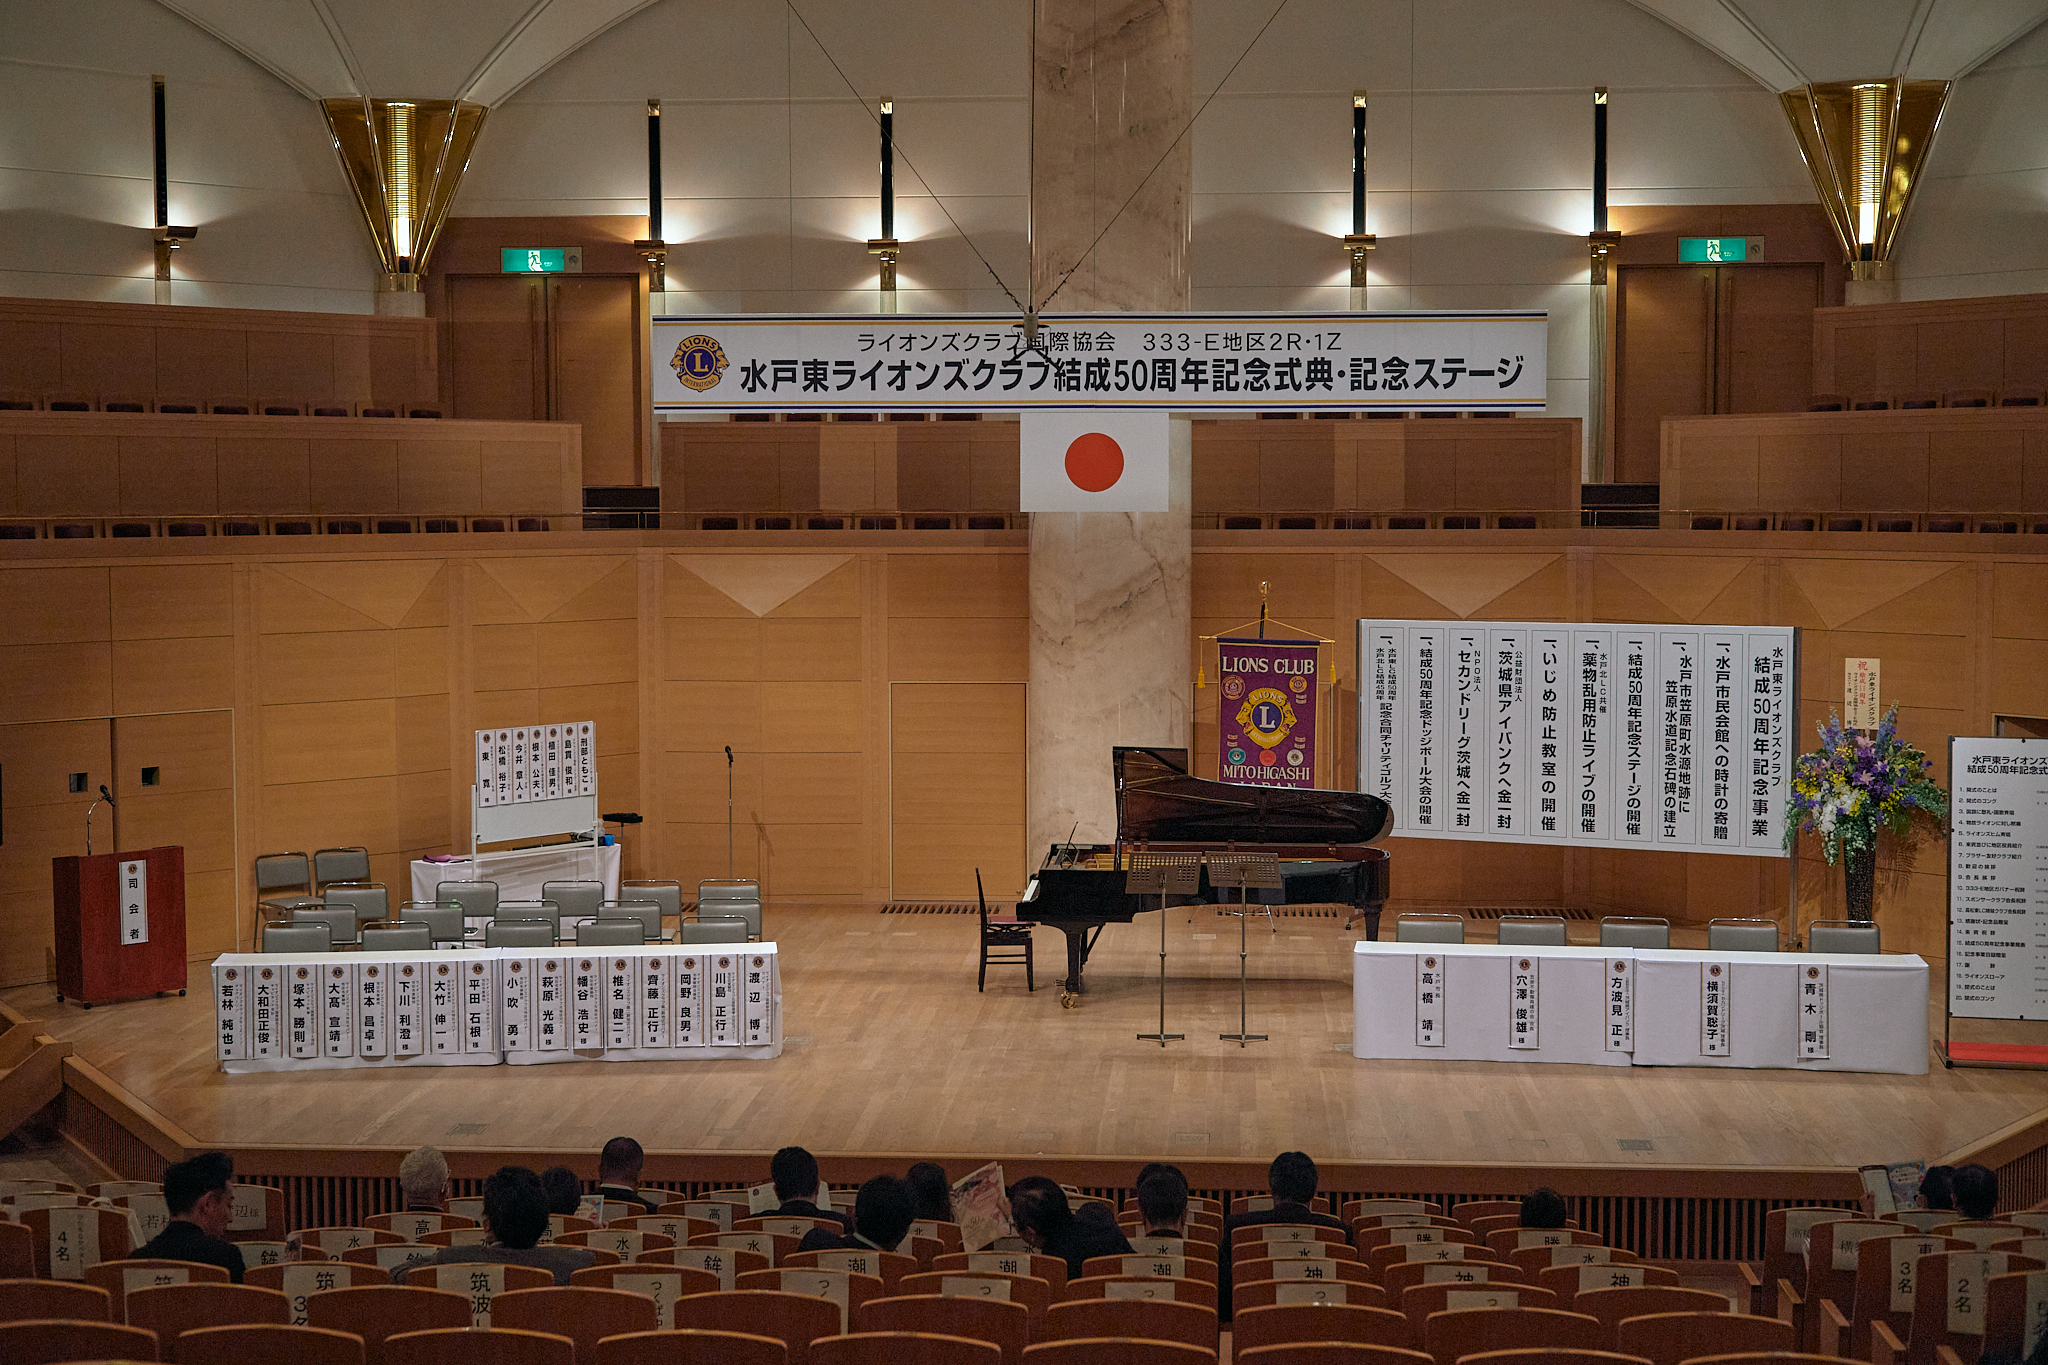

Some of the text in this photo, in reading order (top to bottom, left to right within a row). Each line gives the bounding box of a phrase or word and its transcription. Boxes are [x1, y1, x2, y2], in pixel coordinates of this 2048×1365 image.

[682, 337, 717, 350] LIONS
[693, 352, 709, 373] L
[1221, 656, 1315, 675] LIONS CLUB
[1473, 650, 1482, 692] NPO法人
[1514, 650, 1523, 702] 公益財団法人
[1858, 661, 1868, 671] 祝
[1599, 652, 1608, 713] 水戸北LC共催
[1252, 690, 1284, 704] LIONS
[1258, 705, 1276, 729] L
[1771, 646, 1784, 787] 水戸東ライオンズクラブ
[1419, 636, 1434, 825] 一、結成50周年記念ドッジボール大会の開催
[1456, 637, 1475, 827] 一、セカンドリーグ茨城へ金一封
[1497, 638, 1516, 829] 一、茨城県アイバンクへ金一封
[1541, 638, 1558, 831] 一、いじめ防止教室の開催
[1581, 639, 1600, 834] 一、薬物乱用防止ライブの開催
[1626, 640, 1643, 836] 一、結成50周年記念ステージの開催
[1713, 642, 1731, 840] 一、水戸市民会館への時計の寄贈
[1663, 680, 1678, 838] 笠原水道記念石碑の建立
[1751, 656, 1771, 837] 結成50周年記念事業
[515, 743, 524, 791] 今井 章人
[531, 742, 540, 789] 根本 公夫
[1223, 764, 1310, 780] MITO HIGASHI
[1966, 765, 2048, 775] 結成50周年記念式
[128, 877, 140, 940] 司会者
[221, 984, 234, 1011] 若林
[293, 983, 306, 1009] 塚本
[363, 982, 375, 1007] 根本
[398, 980, 411, 1007] 下川
[434, 980, 446, 1006] 大竹
[469, 979, 480, 1004] 平田
[507, 977, 518, 1008] 小吹
[541, 976, 554, 1002] 萩原
[612, 974, 624, 1001] 椎名
[680, 973, 692, 999] 岡野
[715, 972, 726, 998] 川島
[749, 972, 760, 1003] 渡辺
[1422, 972, 1434, 1004] 高橋
[1516, 974, 1528, 1000] 穴澤
[1611, 977, 1623, 1016] 方波見
[1706, 981, 1719, 1040] 横須賀聡子
[1804, 983, 1817, 1015] 青木
[257, 984, 270, 1044] 大和田正俊
[399, 1014, 411, 1040] 利澄
[434, 1013, 447, 1035] 伸一
[469, 1012, 481, 1038] 石根
[542, 1009, 554, 1035] 光義
[577, 1008, 589, 1034] 浩史
[612, 1008, 624, 1032] 健二
[647, 1007, 659, 1032] 正行
[680, 1006, 691, 1032] 良男
[715, 1005, 727, 1031] 正行
[749, 1018, 761, 1031] 博
[1422, 1019, 1434, 1032] 靖
[1516, 1007, 1528, 1033] 俊雄
[221, 1018, 234, 1045] 純也
[293, 1017, 306, 1043] 勝則
[364, 1015, 375, 1041] 昌卓
[507, 1024, 519, 1036] 勇
[1611, 1024, 1623, 1036] 正
[1804, 1030, 1817, 1043] 剛
[55, 1231, 71, 1262] 4名
[348, 1235, 361, 1248] 水
[747, 1240, 760, 1252] 水
[1897, 1262, 1912, 1295] 3名
[470, 1272, 491, 1327] 筑波
[1954, 1278, 1972, 1314] 2名
